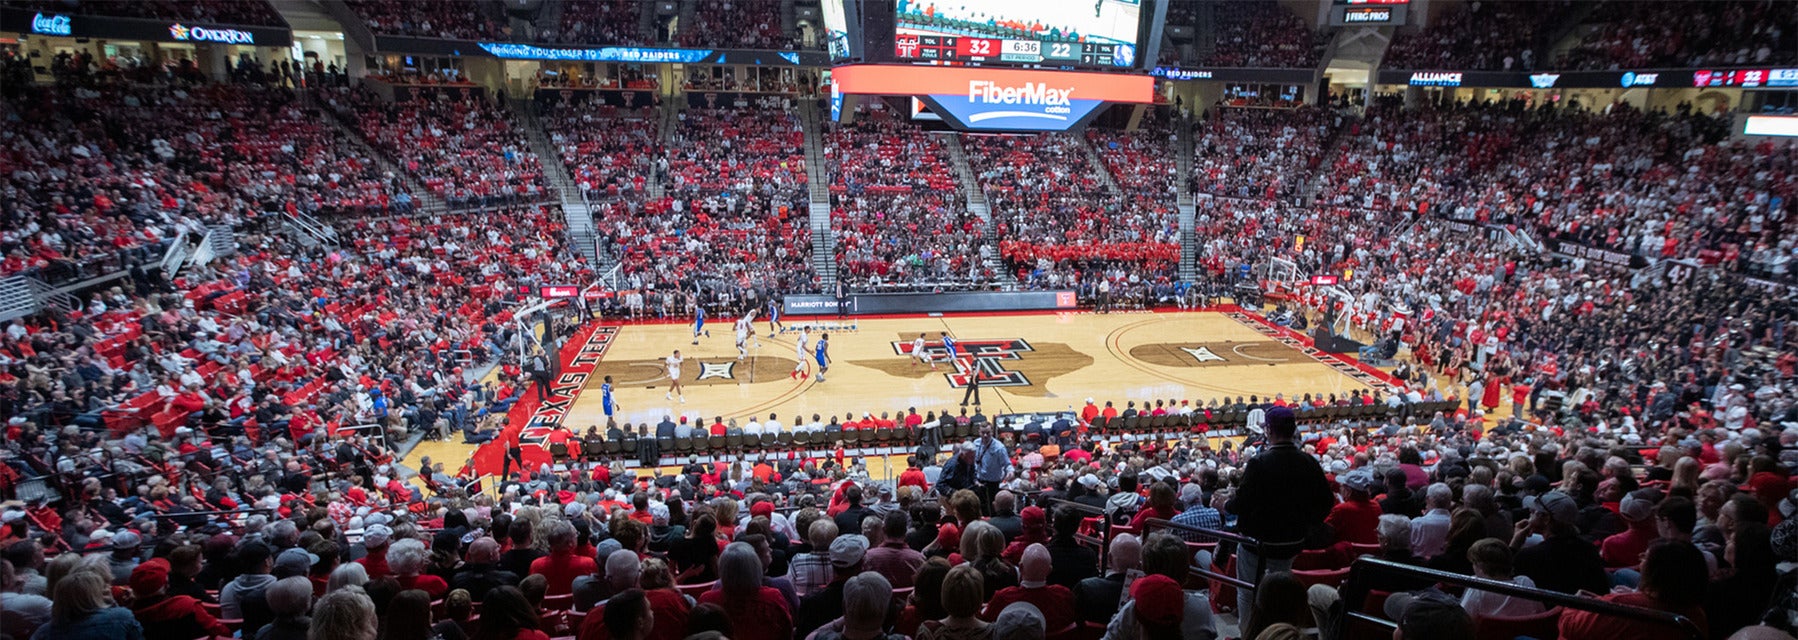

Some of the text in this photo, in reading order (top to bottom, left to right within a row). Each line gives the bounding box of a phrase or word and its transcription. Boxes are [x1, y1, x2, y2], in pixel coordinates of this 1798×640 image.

[1370, 12, 1390, 20] PROS
[190, 26, 254, 44] OVERTON
[969, 39, 990, 54] 32
[1013, 42, 1038, 52] 6:36
[1050, 43, 1071, 57] 22
[1086, 44, 1092, 52] 2
[642, 51, 680, 60] RAIDERS
[946, 49, 952, 57] 4
[1085, 55, 1091, 63] 9
[1411, 72, 1462, 82] ALLIANCE
[969, 80, 1071, 106] FiberMax
[1045, 106, 1071, 114] cotton
[519, 326, 619, 447] TEXAS TECH
